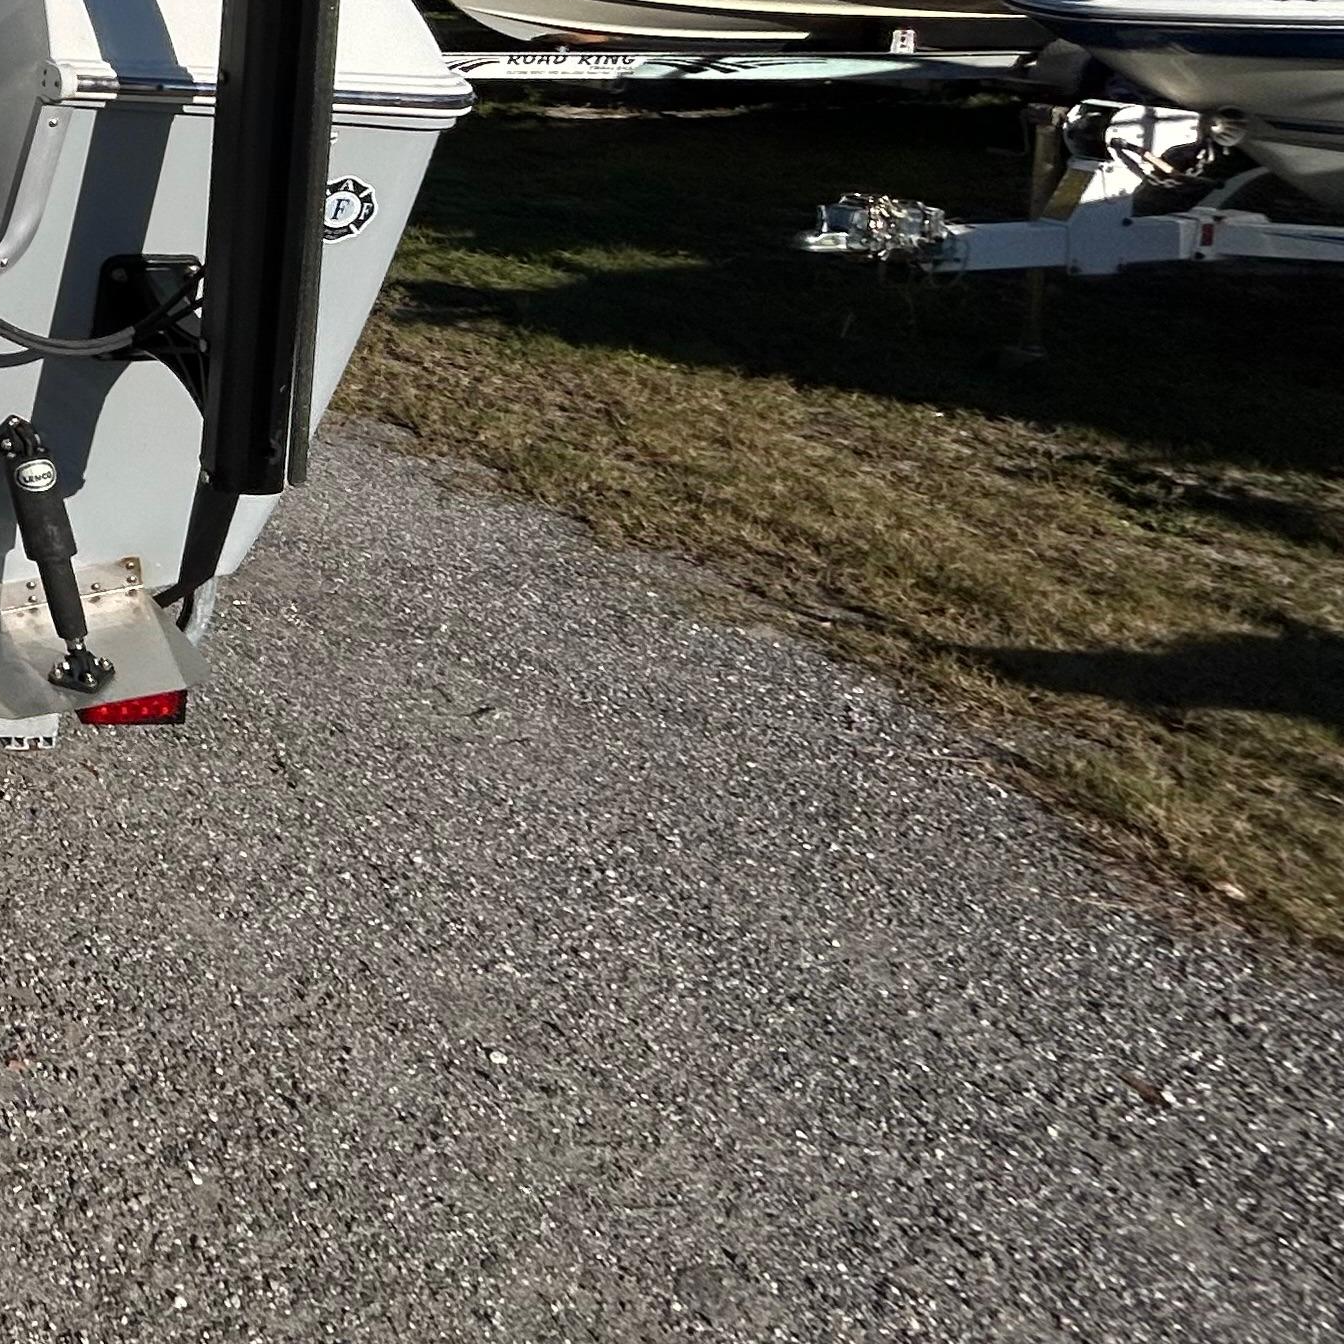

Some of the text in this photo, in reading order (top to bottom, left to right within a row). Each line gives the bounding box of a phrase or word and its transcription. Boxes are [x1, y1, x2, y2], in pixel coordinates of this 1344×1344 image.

[507, 55, 635, 66] ROAD KING
[331, 198, 351, 221] F
